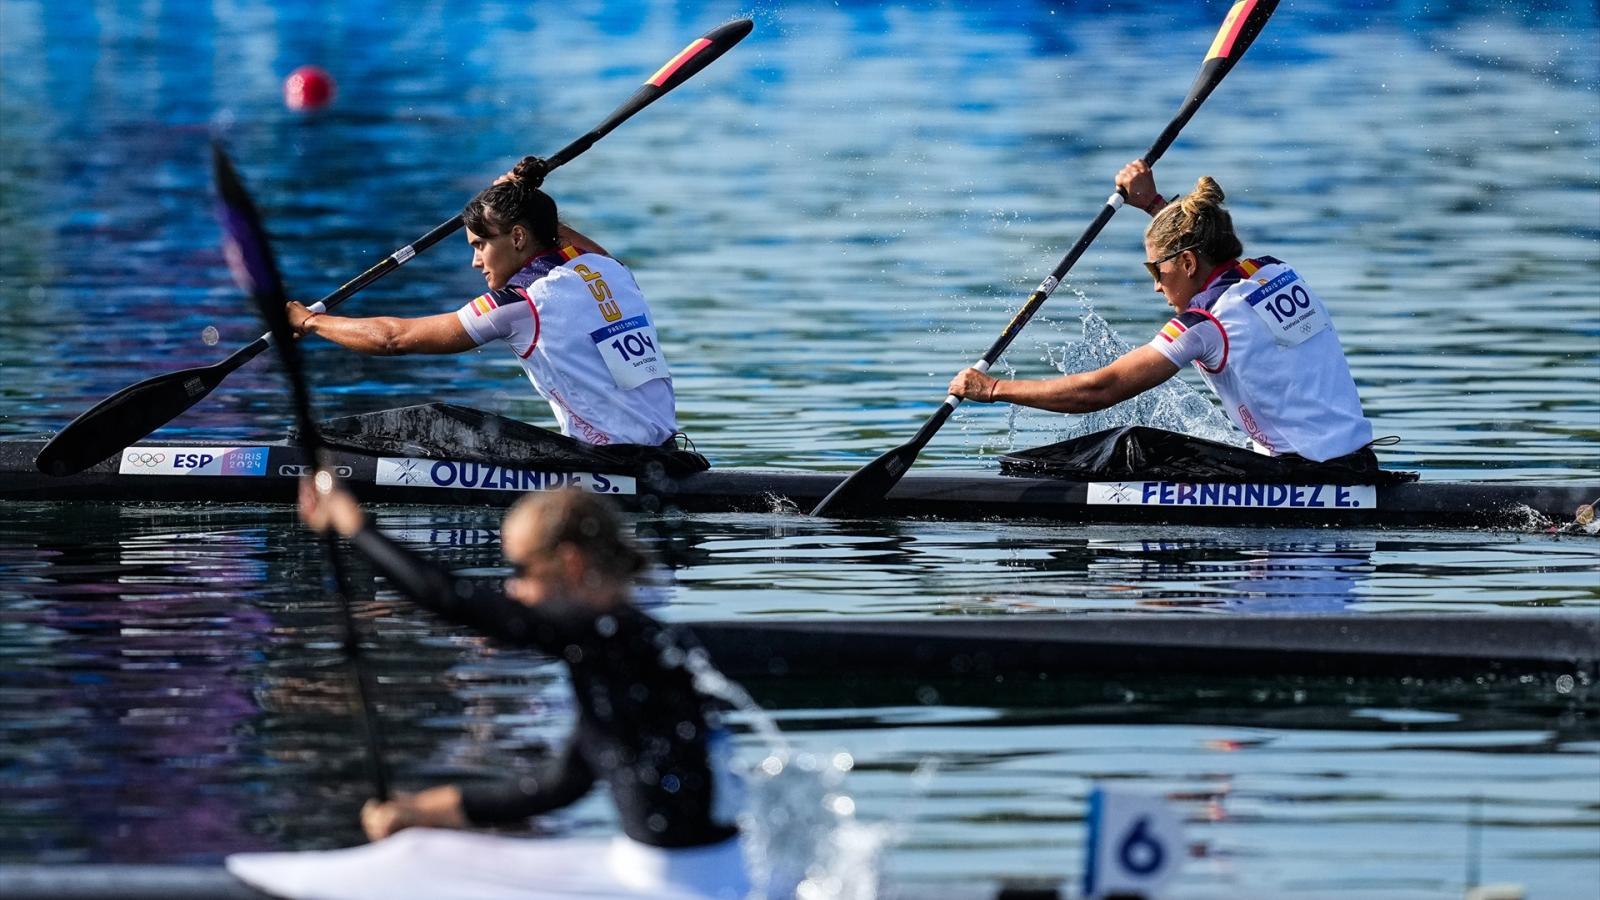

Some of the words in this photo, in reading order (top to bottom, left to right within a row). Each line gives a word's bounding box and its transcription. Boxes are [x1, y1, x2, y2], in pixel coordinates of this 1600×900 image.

[573, 263, 623, 323] ESP
[1264, 284, 1310, 324] 100
[611, 331, 657, 362] 104
[173, 454, 214, 468] ESP
[229, 460, 261, 469] 2024
[230, 453, 262, 461] PARIS
[592, 473, 620, 493] S.
[1142, 481, 1325, 508] FERNANDEZ
[1335, 484, 1360, 508] E.
[1118, 815, 1165, 877] 6
